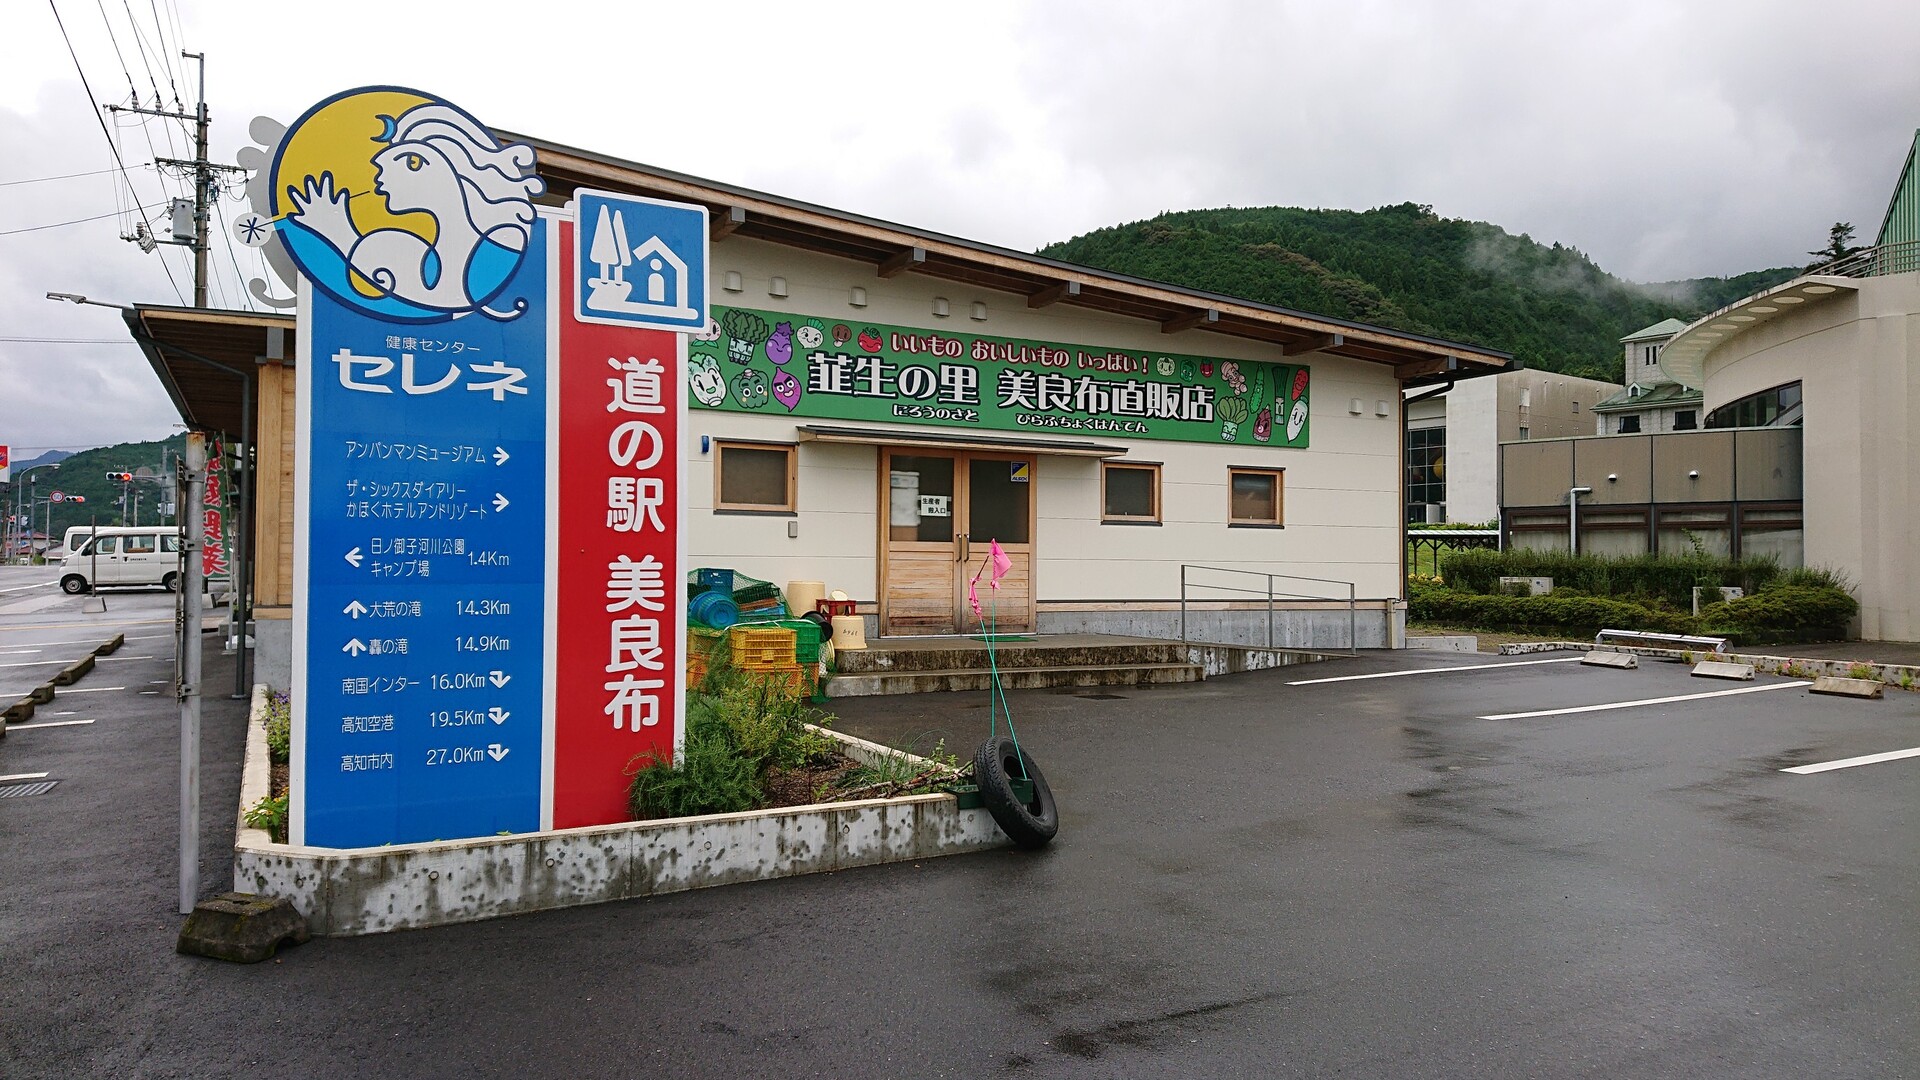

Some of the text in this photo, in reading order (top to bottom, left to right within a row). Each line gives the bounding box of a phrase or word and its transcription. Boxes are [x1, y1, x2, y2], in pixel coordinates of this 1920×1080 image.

[385, 335, 480, 354] 健康センター
[892, 333, 963, 357] いいもの
[971, 340, 1070, 368] おいしいもの
[331, 347, 528, 401] セレネ
[997, 370, 1215, 421] 美良布直販店
[345, 440, 486, 464] アンパンマンミュージアム
[346, 479, 466, 500] ザ・シックスダイアリー
[346, 501, 488, 521] かほくホテルアンドリゾート
[371, 537, 466, 556] 日ノ御子河川公園
[604, 355, 666, 733] 道の駅 美良布
[370, 560, 430, 578] キャンプ場
[467, 550, 511, 567] 1.4Km
[369, 599, 510, 618] 大荒の滝 14.3Km
[368, 635, 510, 656] 轟の滝 14.9Km
[341, 672, 486, 696] 南国インター 16.0Km
[341, 709, 485, 734] 高知空港 19.5Km
[340, 747, 484, 773] 高知市内 27.0Km
